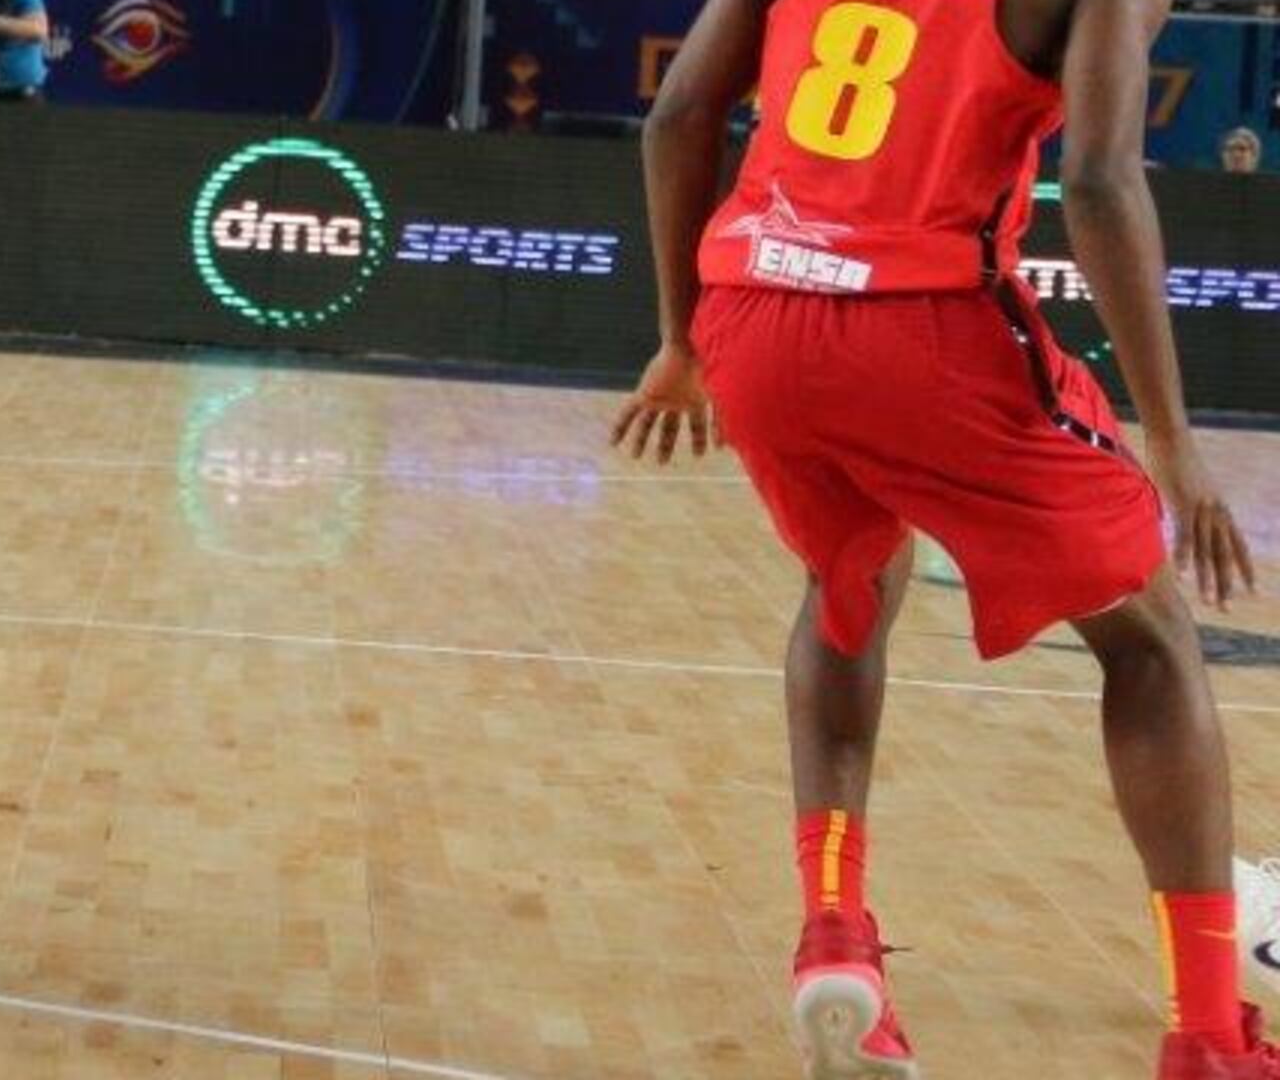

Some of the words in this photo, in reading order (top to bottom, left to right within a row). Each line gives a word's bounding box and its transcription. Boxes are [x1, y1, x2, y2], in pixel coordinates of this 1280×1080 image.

[784, 1, 919, 162] 8
[211, 200, 363, 257] dmc
[396, 222, 620, 275] SPORTS
